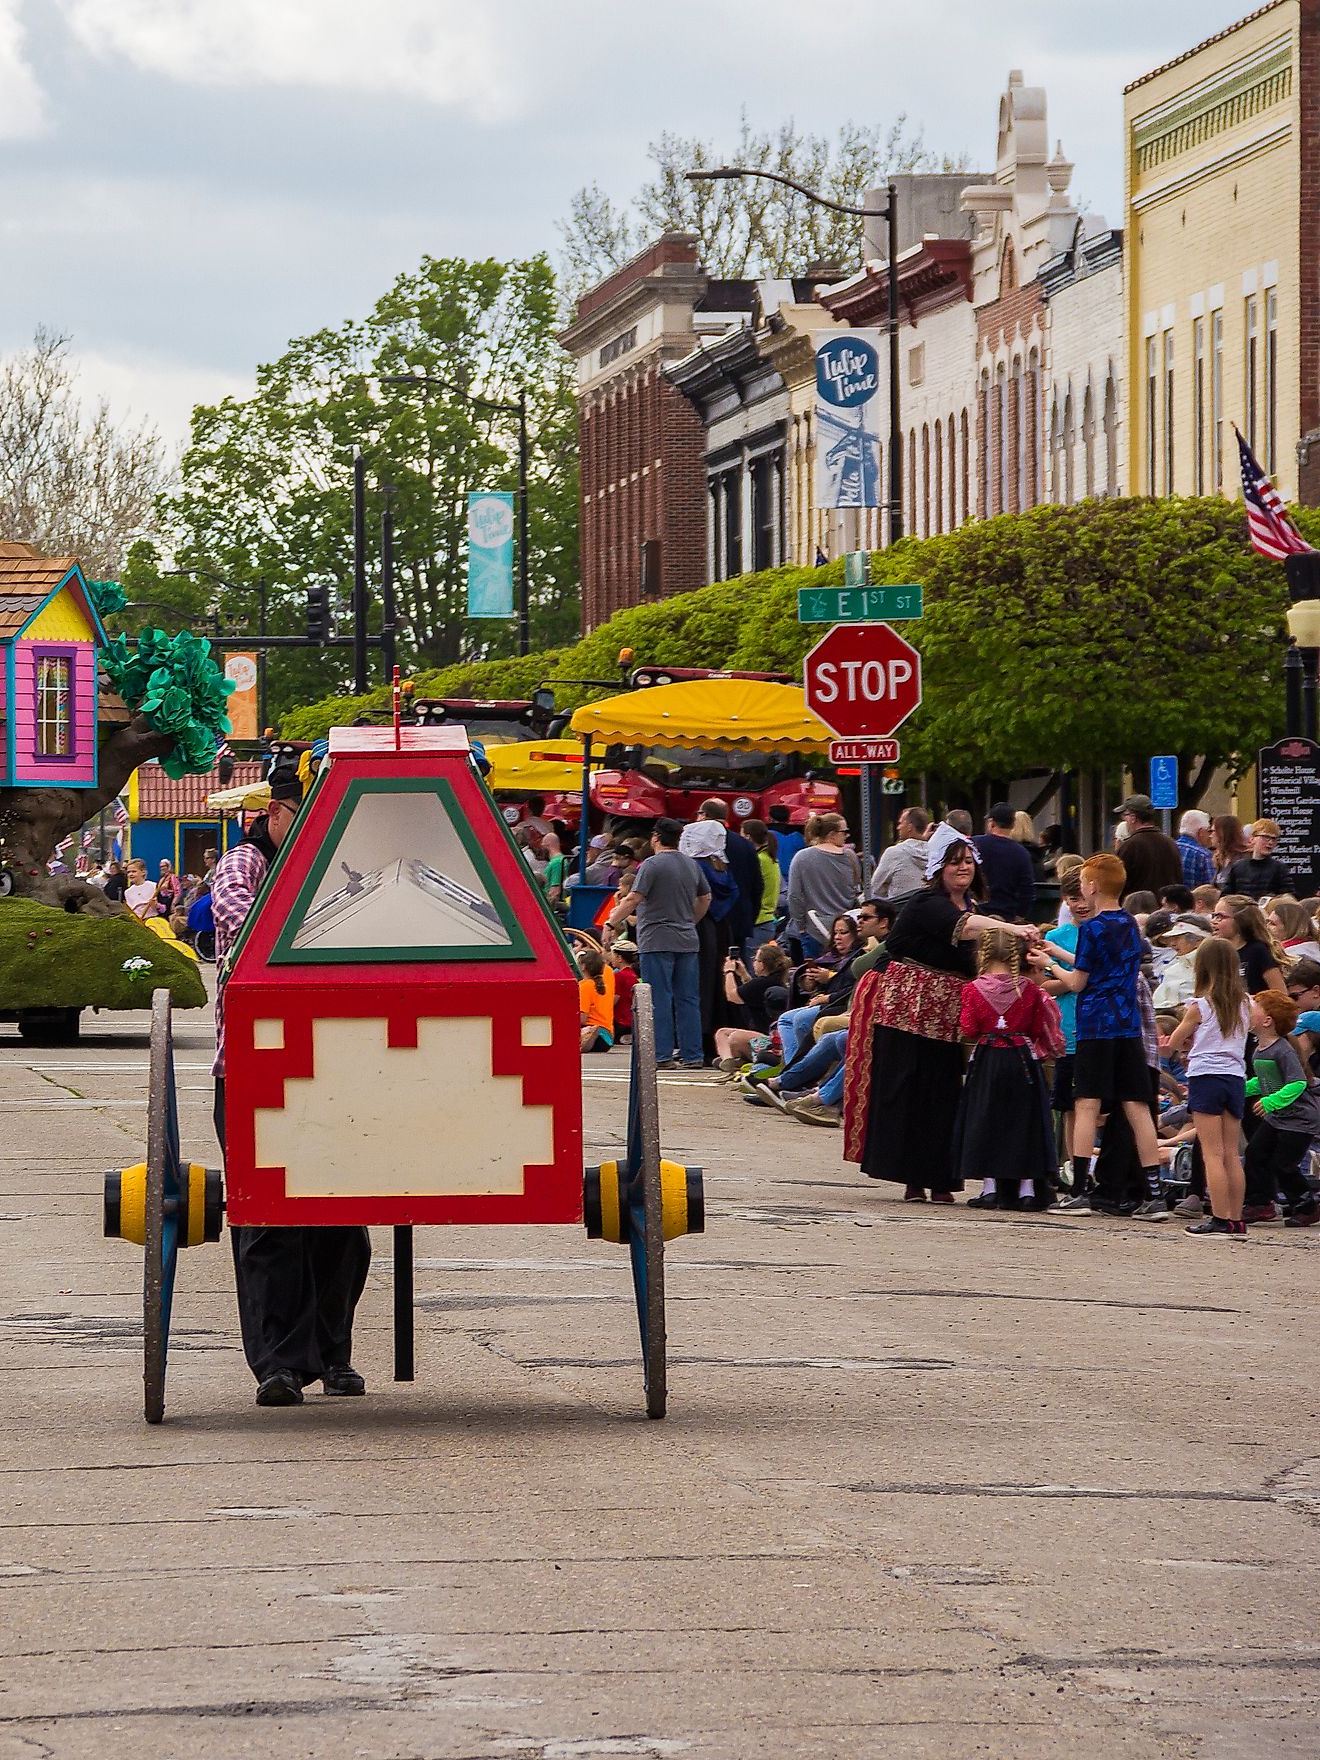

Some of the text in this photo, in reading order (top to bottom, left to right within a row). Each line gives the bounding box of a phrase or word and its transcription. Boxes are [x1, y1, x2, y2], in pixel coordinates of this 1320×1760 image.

[818, 348, 868, 380] Tulip
[830, 373, 878, 401] Time
[471, 507, 505, 529] Tulip
[838, 590, 912, 616] E 1ST ST
[815, 659, 913, 703] STOP
[835, 744, 894, 759] ALL WAY
[1294, 765, 1316, 774] House
[1270, 776, 1302, 785] Historical
[1270, 786, 1301, 795] Windmill
[1270, 807, 1314, 816] Opera House
[1297, 865, 1313, 874] Park
